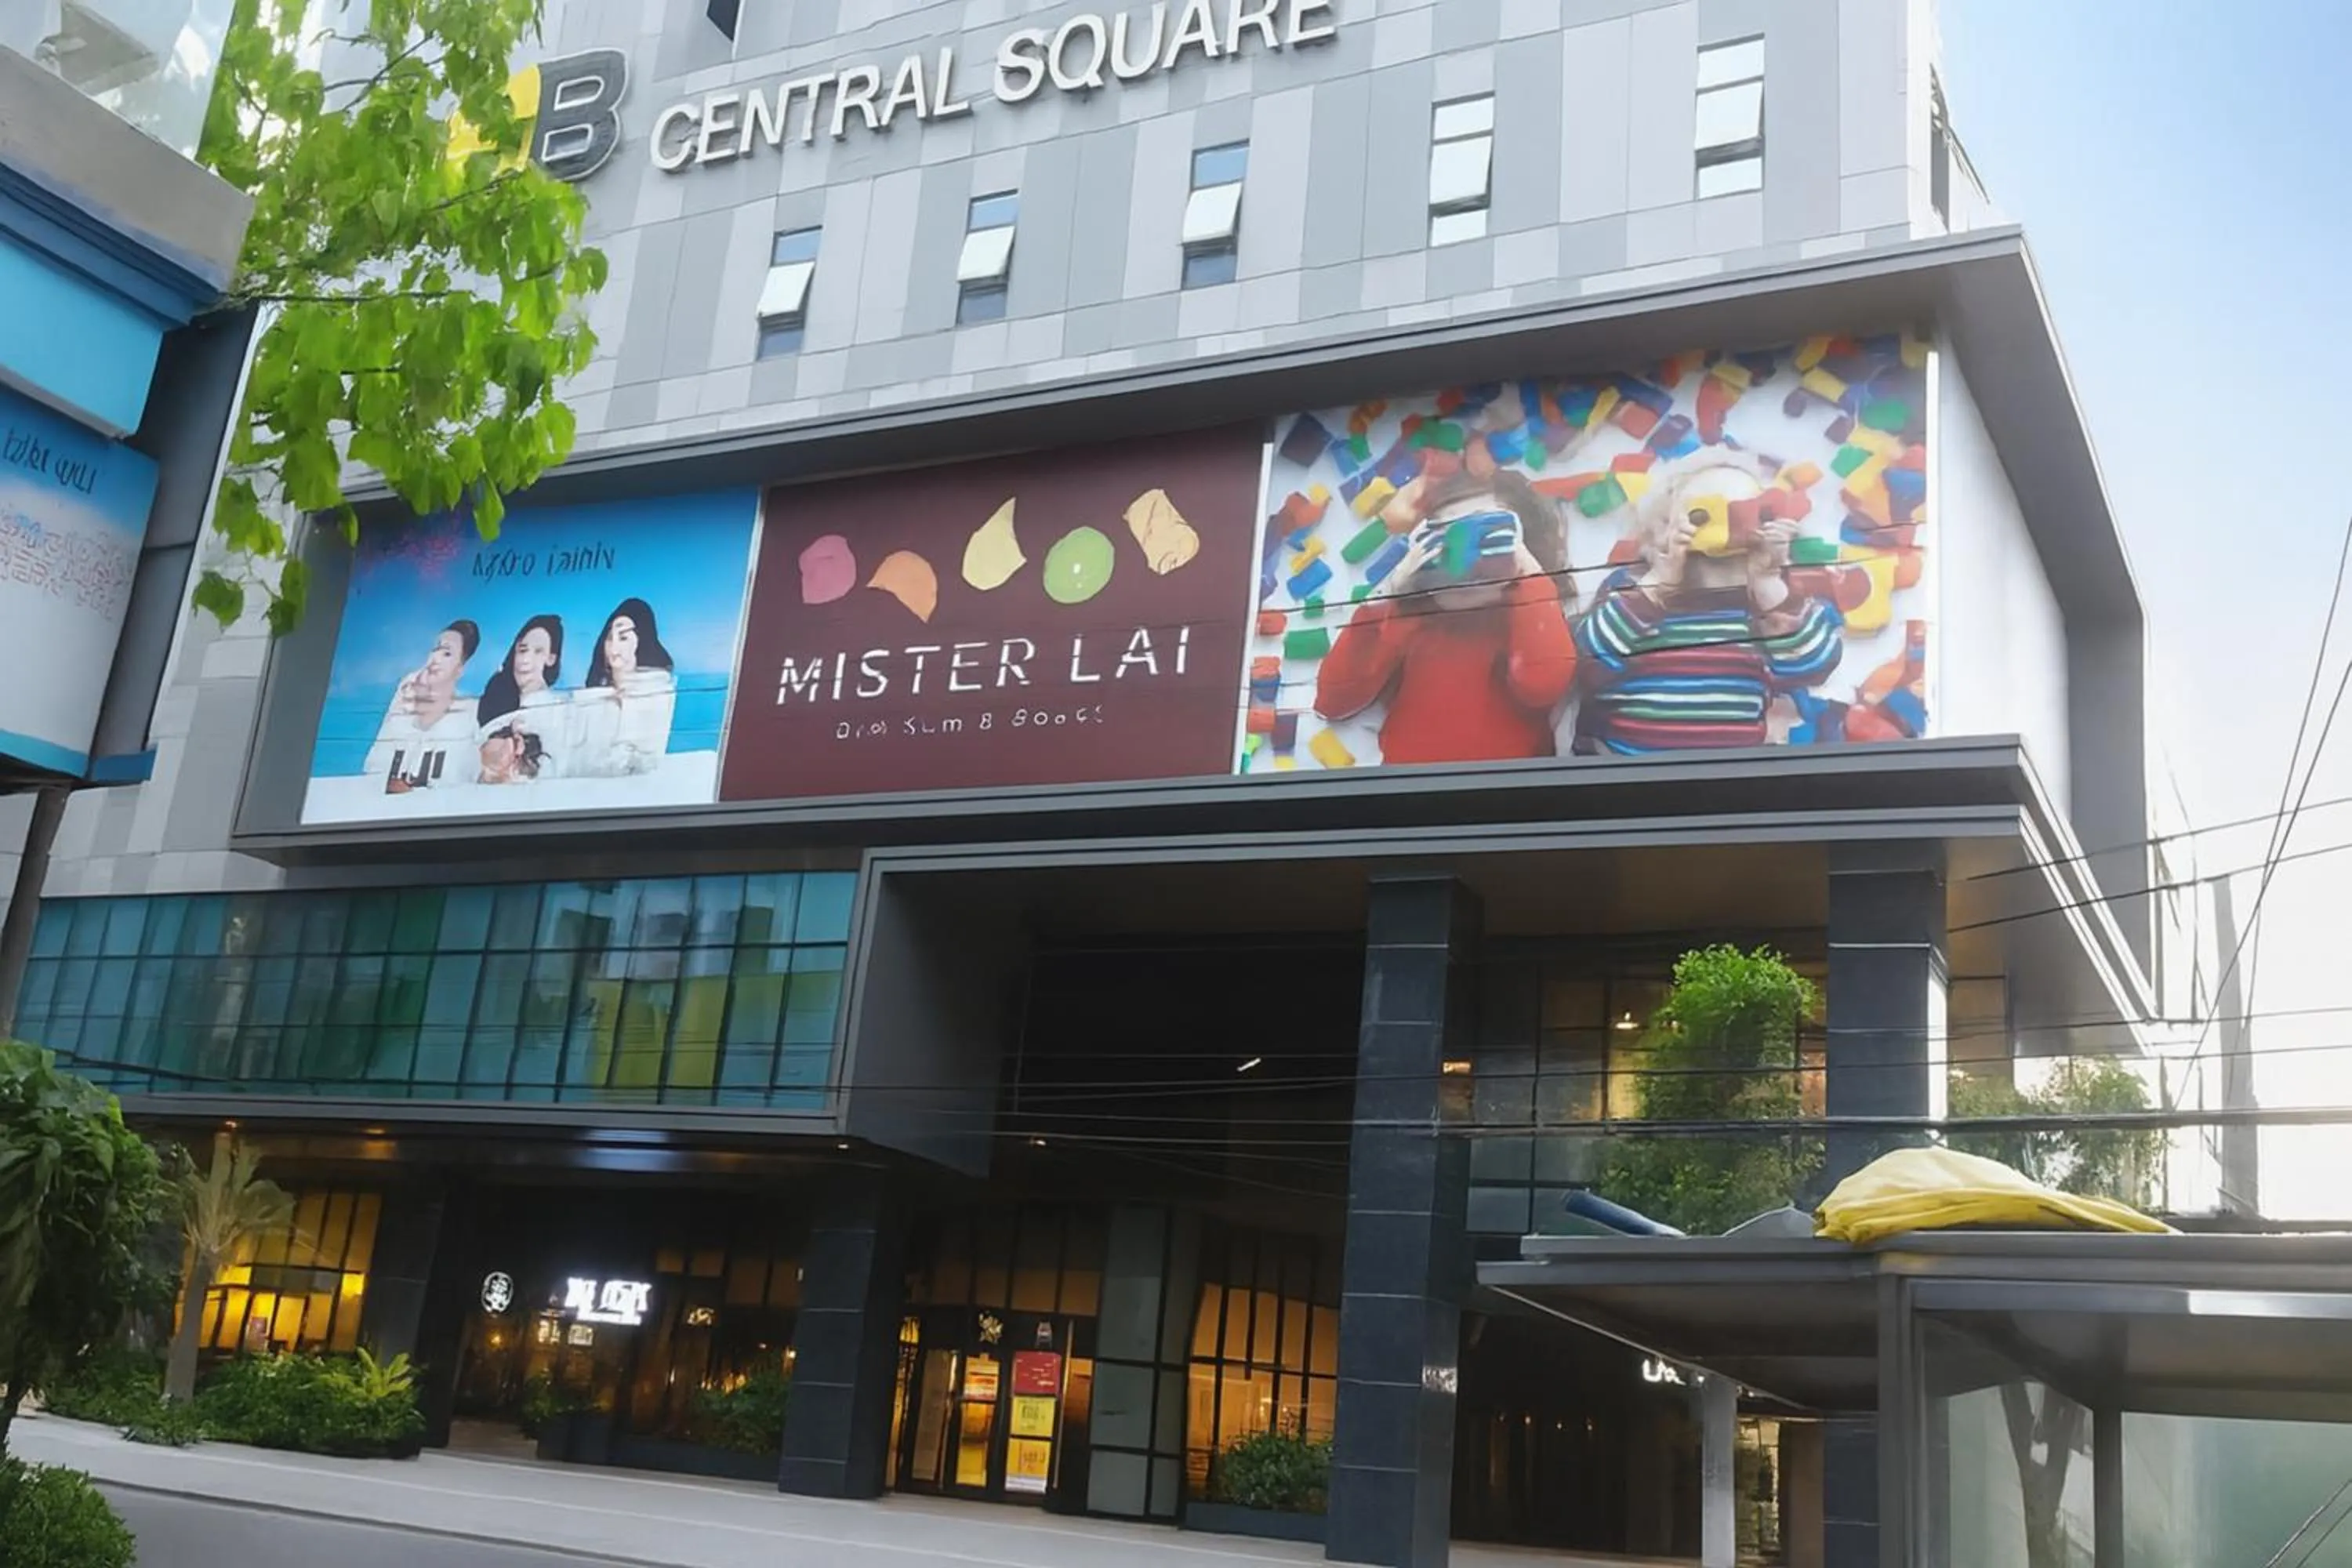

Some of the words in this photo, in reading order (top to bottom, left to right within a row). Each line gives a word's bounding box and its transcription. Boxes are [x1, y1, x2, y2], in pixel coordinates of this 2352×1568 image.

[649, 47, 972, 172] CENTRAL
[992, 0, 1335, 106] SQUARE
[777, 637, 1036, 706] MISTER
[1069, 626, 1190, 683] LAI
